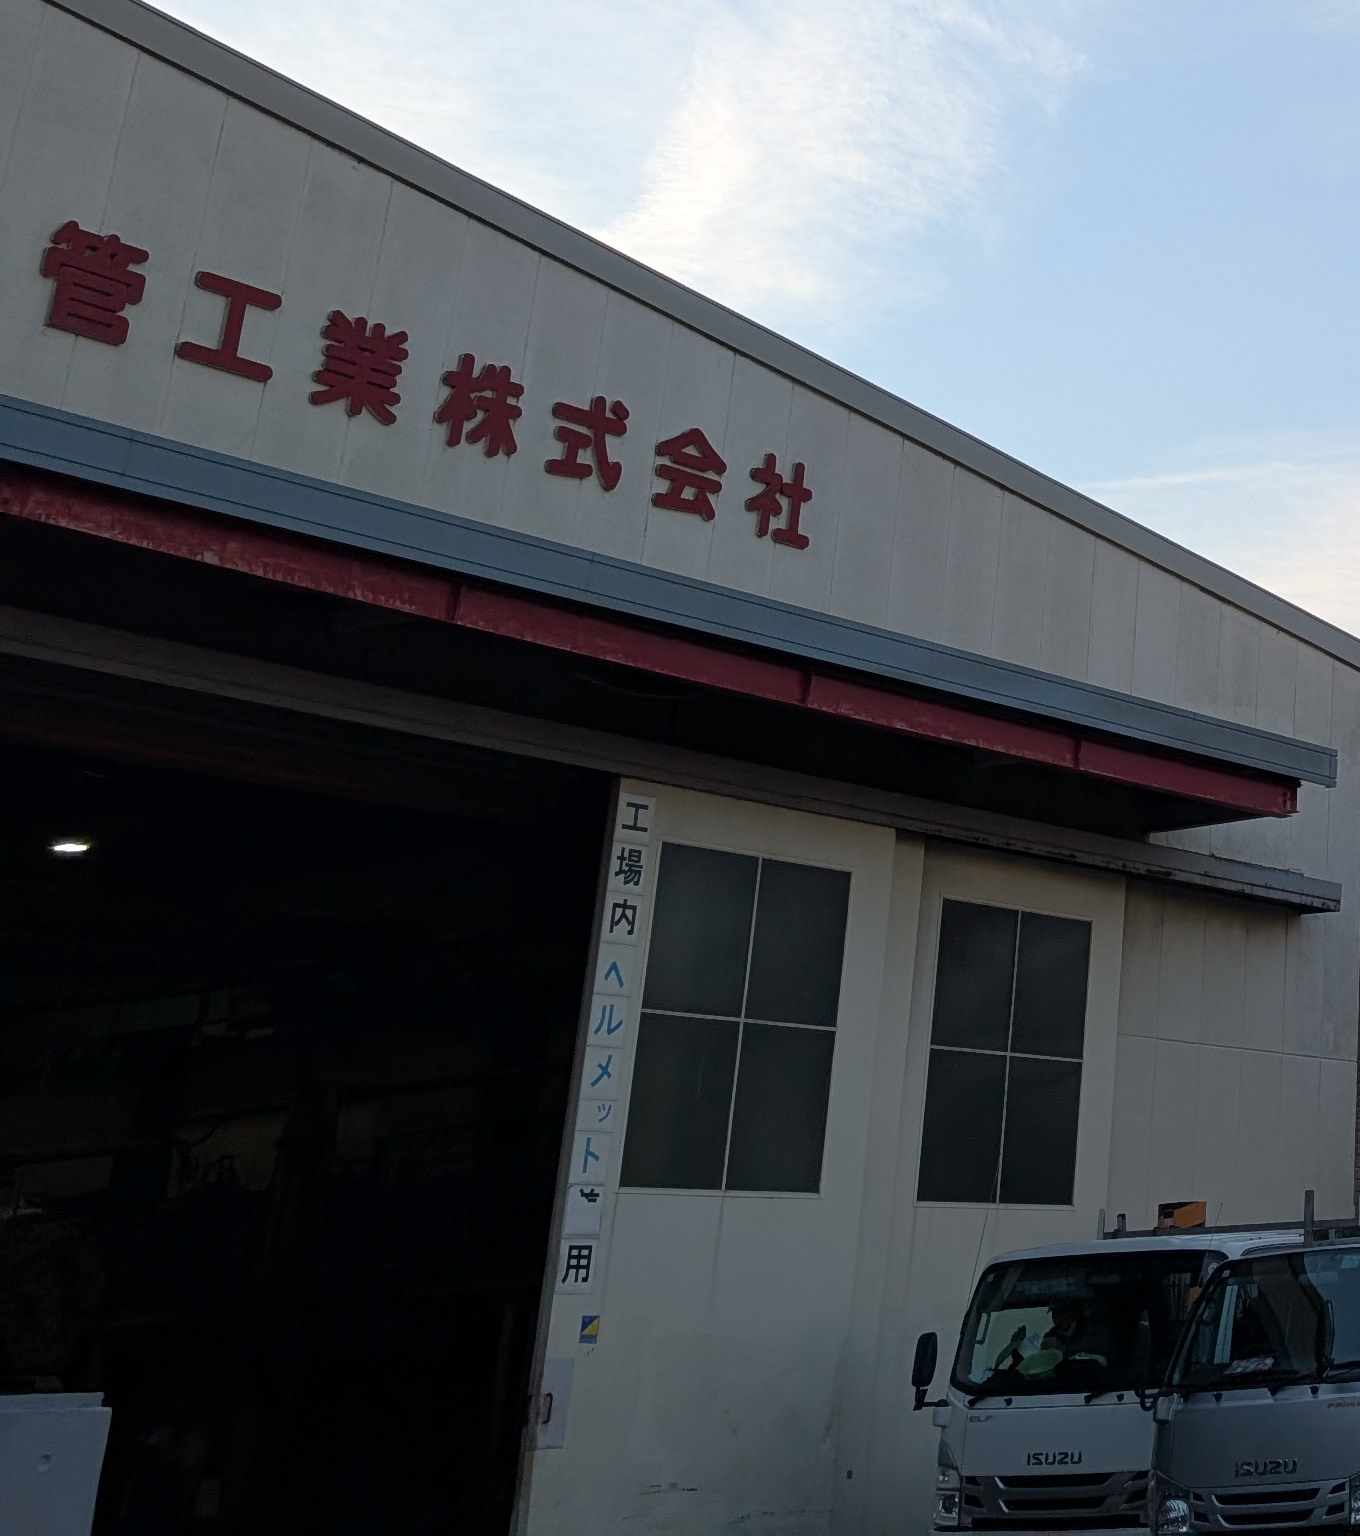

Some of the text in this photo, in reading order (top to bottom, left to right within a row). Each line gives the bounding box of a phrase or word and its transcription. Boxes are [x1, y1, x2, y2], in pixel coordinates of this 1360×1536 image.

[40, 219, 813, 551] 管工業株式会社
[561, 801, 649, 1284] 工場内ヘルメット用
[1026, 1450, 1083, 1466] ISUZU
[1234, 1457, 1298, 1478] ISUZU
